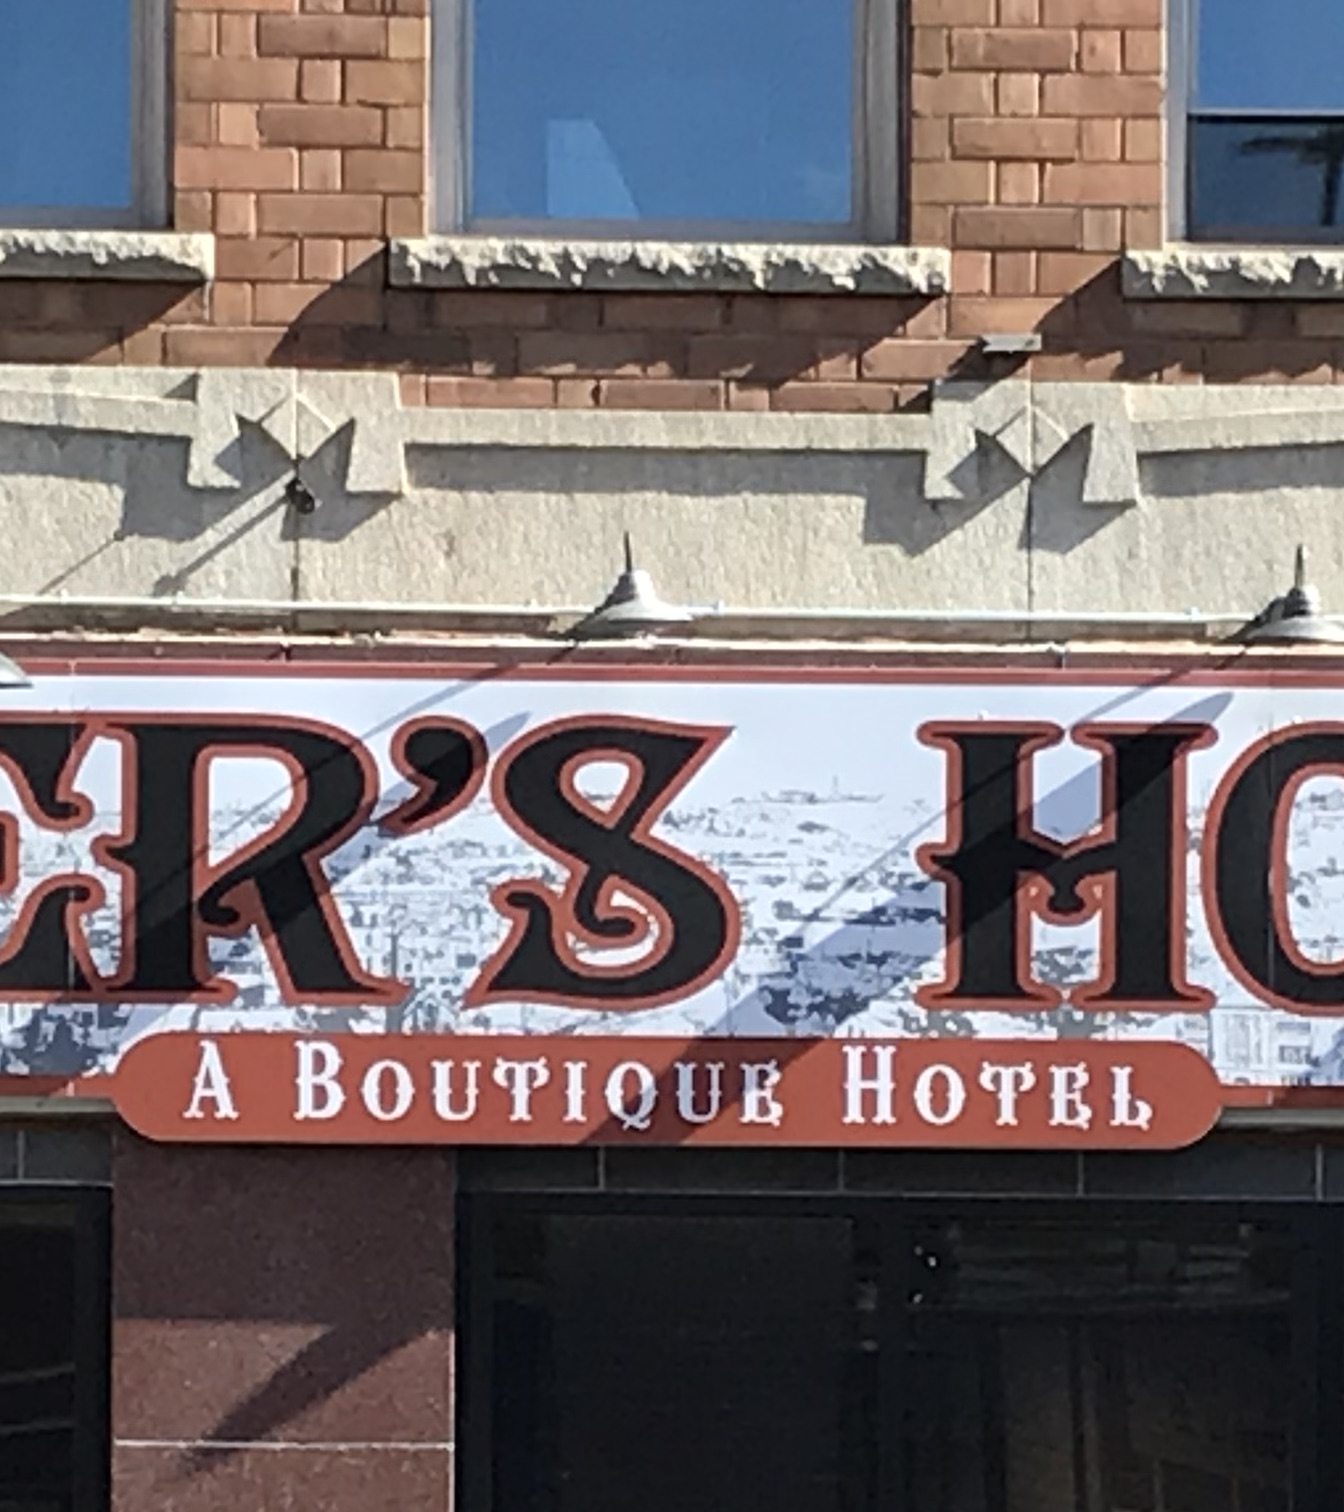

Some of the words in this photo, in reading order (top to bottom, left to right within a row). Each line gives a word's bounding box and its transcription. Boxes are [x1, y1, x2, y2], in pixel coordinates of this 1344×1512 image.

[184, 1040, 238, 1120] A
[294, 1040, 784, 1128] BOUTIQUE
[843, 1044, 1155, 1133] HOTEL
